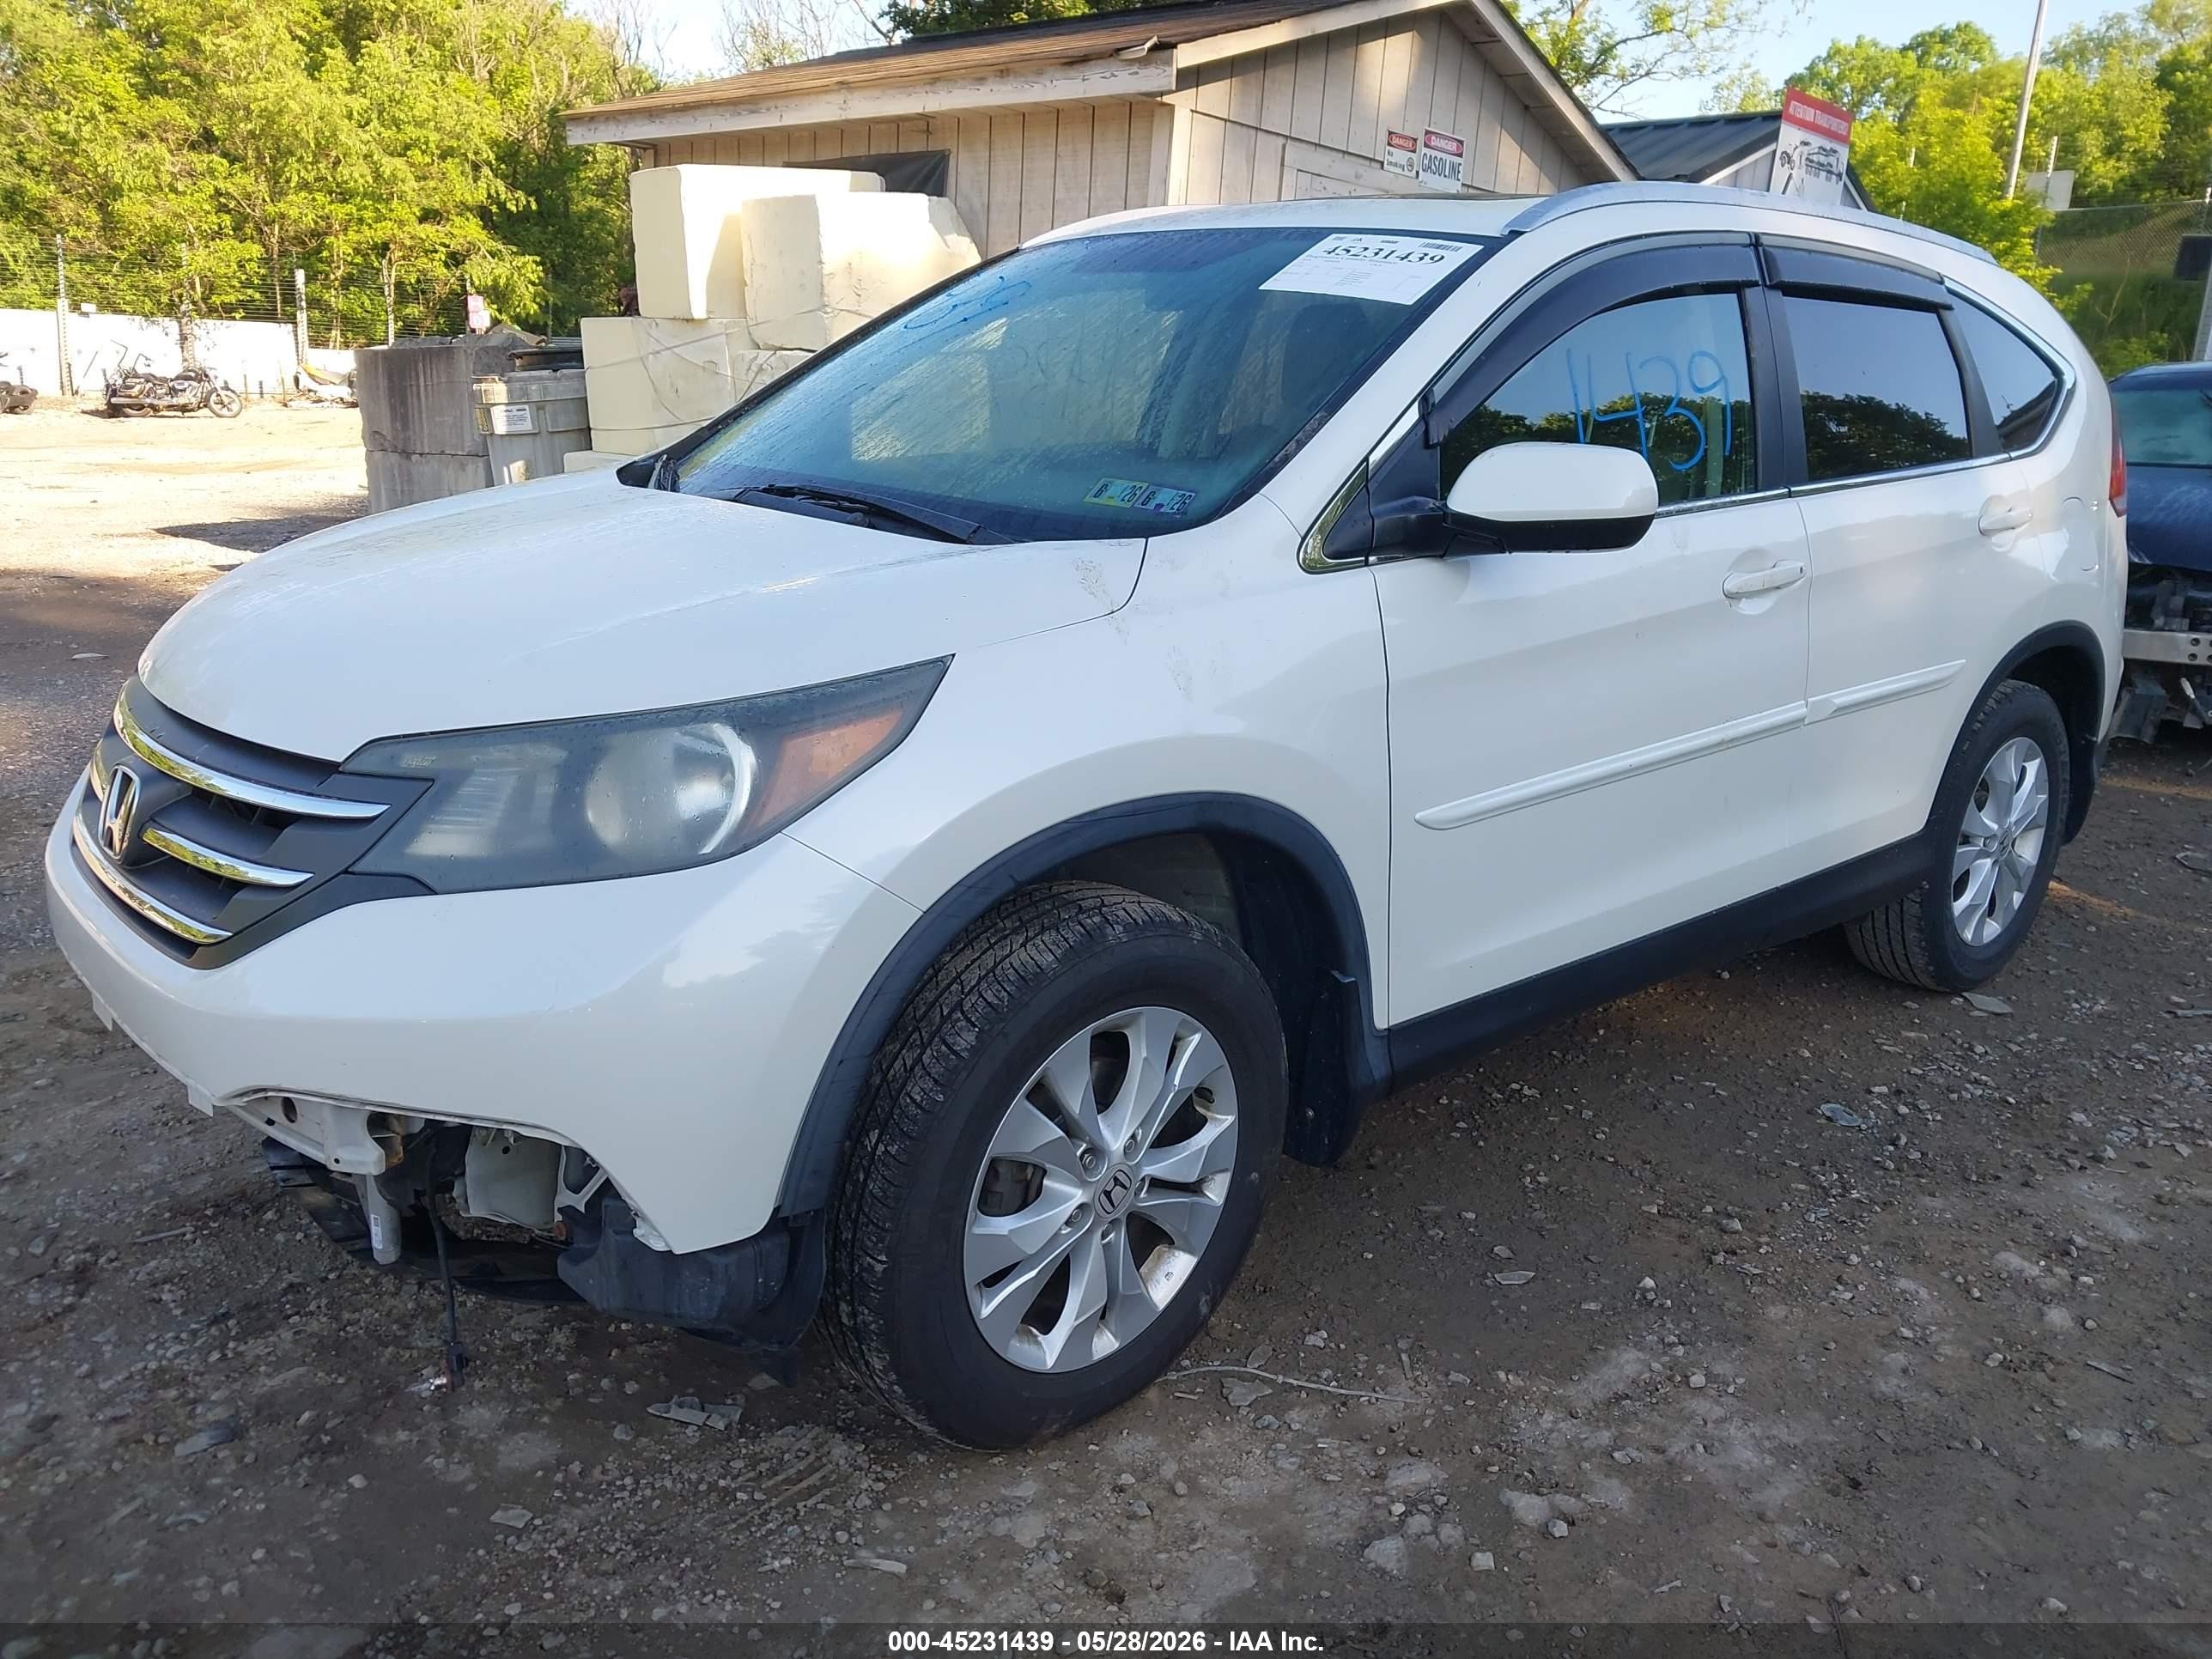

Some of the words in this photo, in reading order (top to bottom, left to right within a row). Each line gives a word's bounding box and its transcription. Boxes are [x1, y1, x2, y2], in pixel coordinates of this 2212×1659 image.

[1392, 135, 1413, 148] DANGER
[1431, 136, 1457, 152] DANGER
[1422, 153, 1462, 181] GASOLINE
[1323, 245, 1446, 264] 45231439
[1566, 349, 1732, 471] 1439
